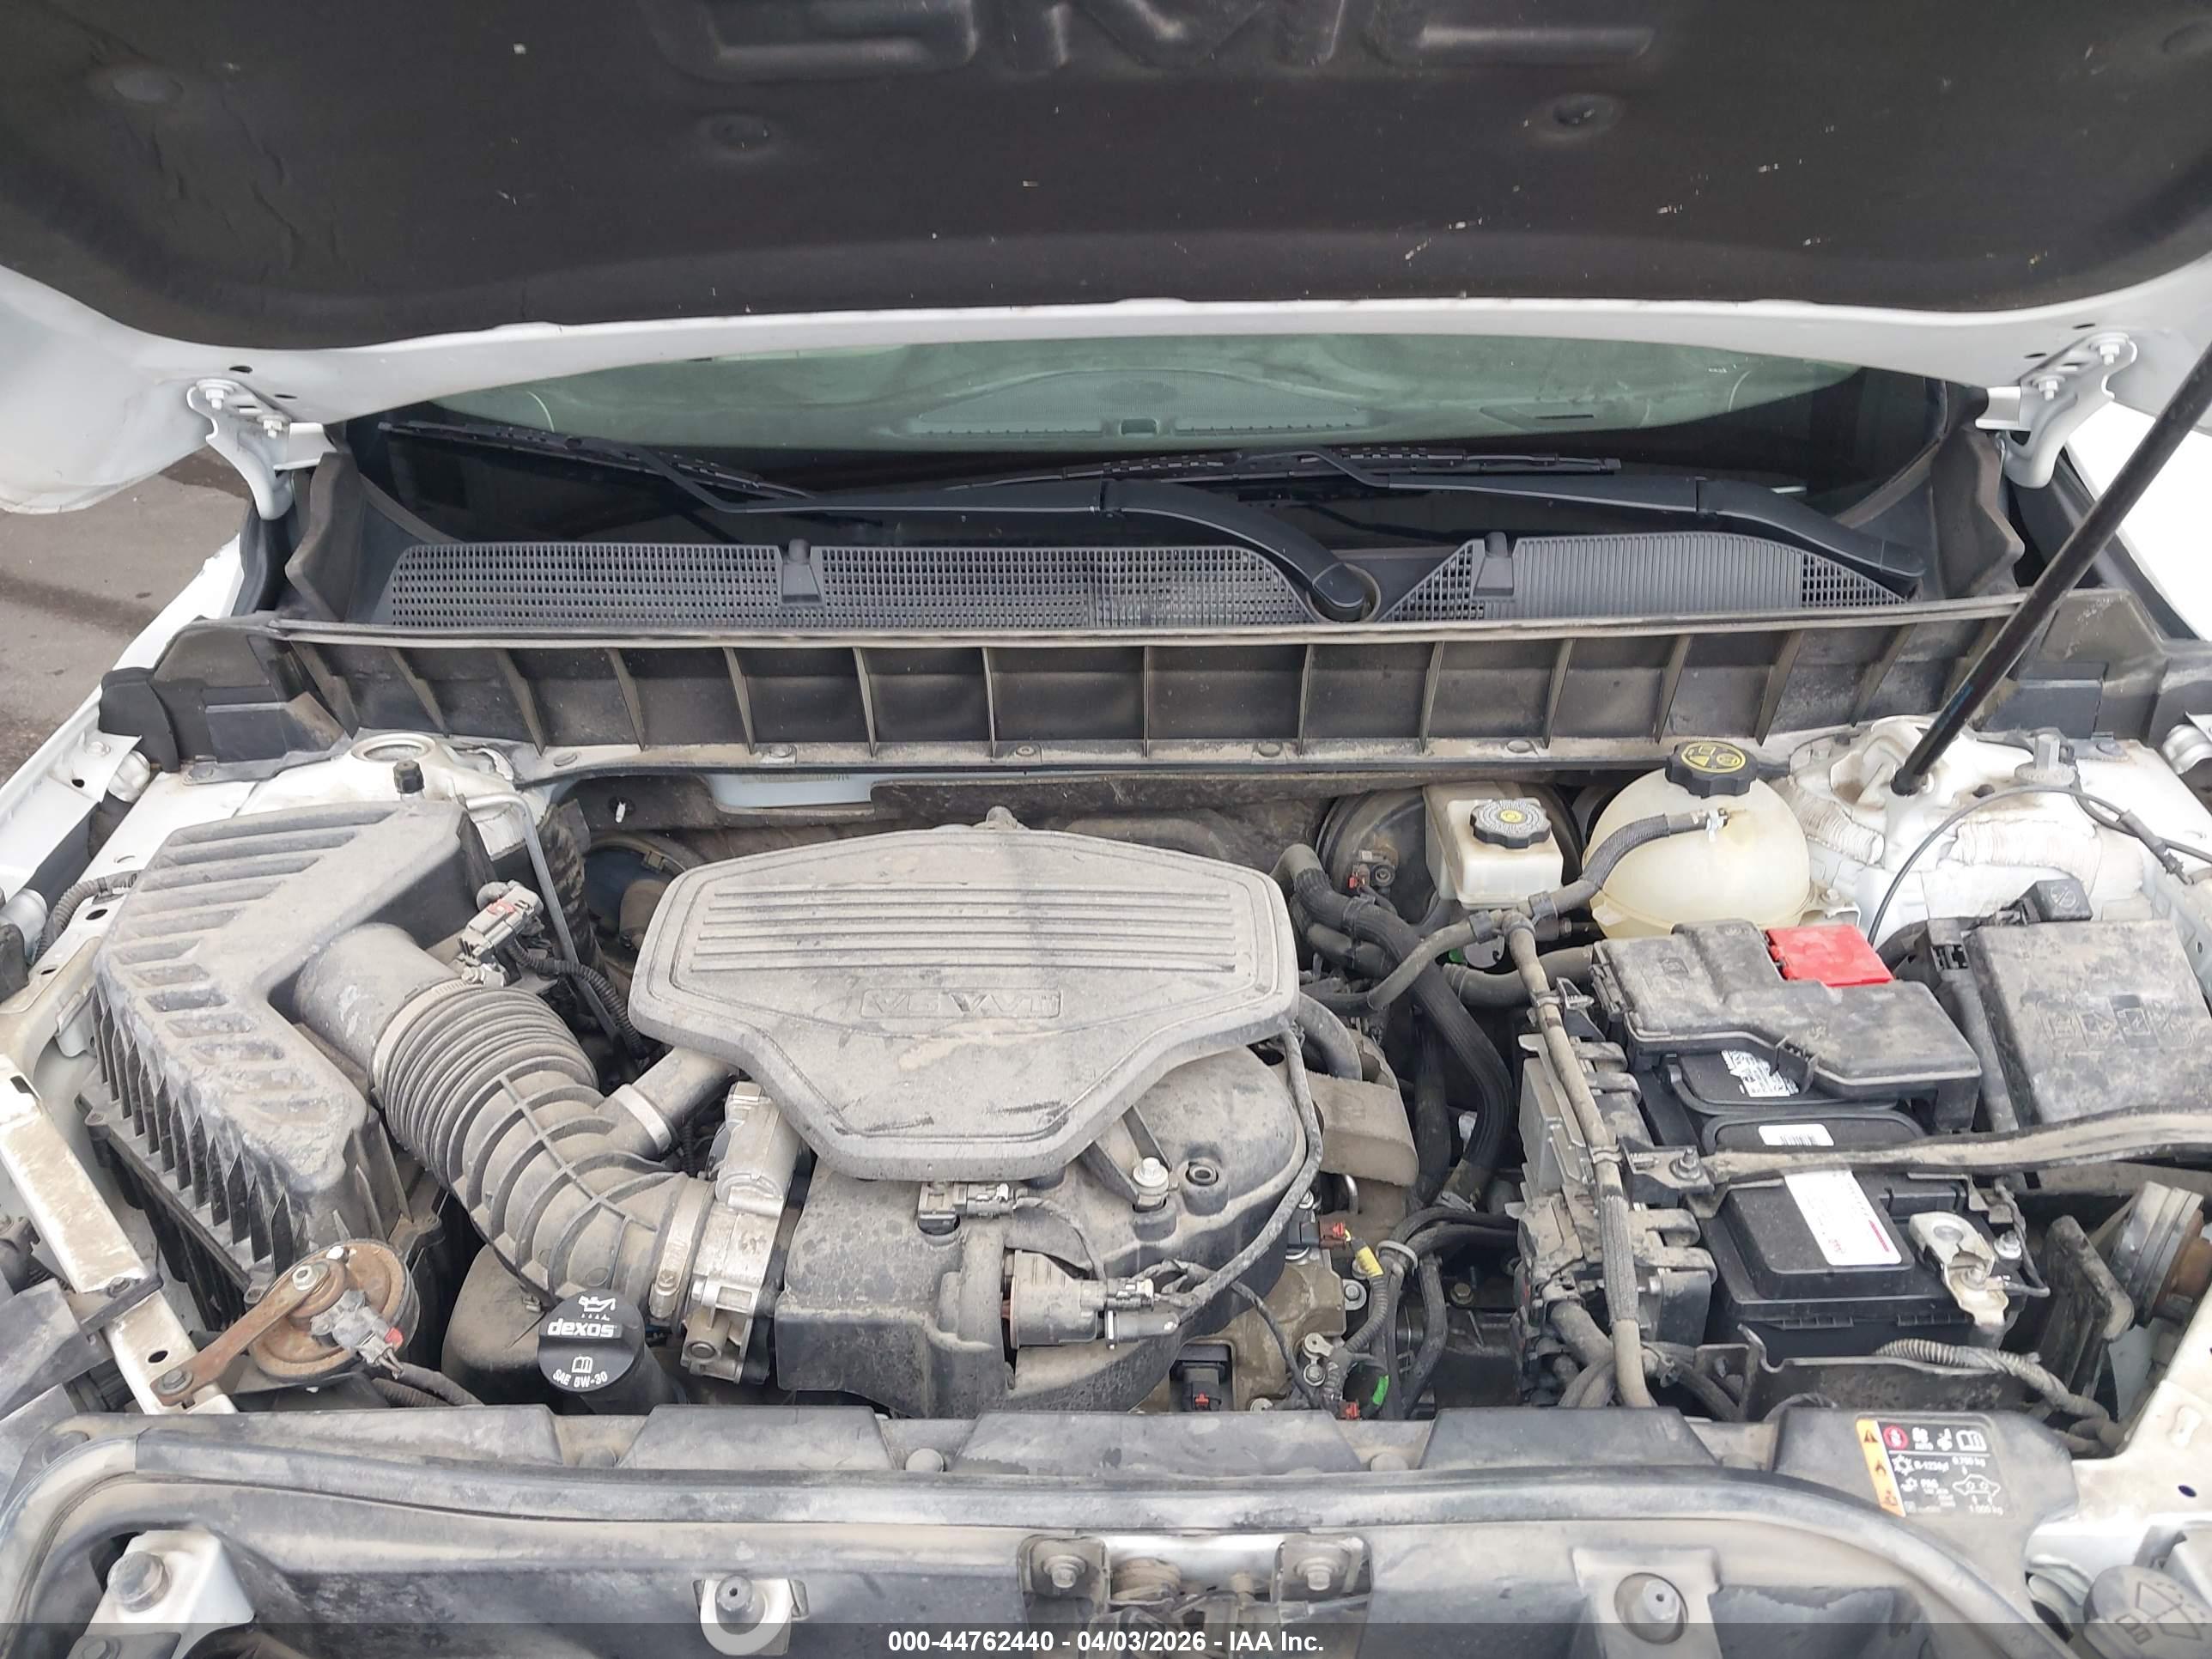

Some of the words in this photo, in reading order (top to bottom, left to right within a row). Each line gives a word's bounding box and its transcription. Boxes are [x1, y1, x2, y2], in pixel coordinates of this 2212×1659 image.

[548, 1317, 615, 1338] dexos
[552, 1369, 572, 1386] SAE
[574, 1370, 608, 1388] 5W-30
